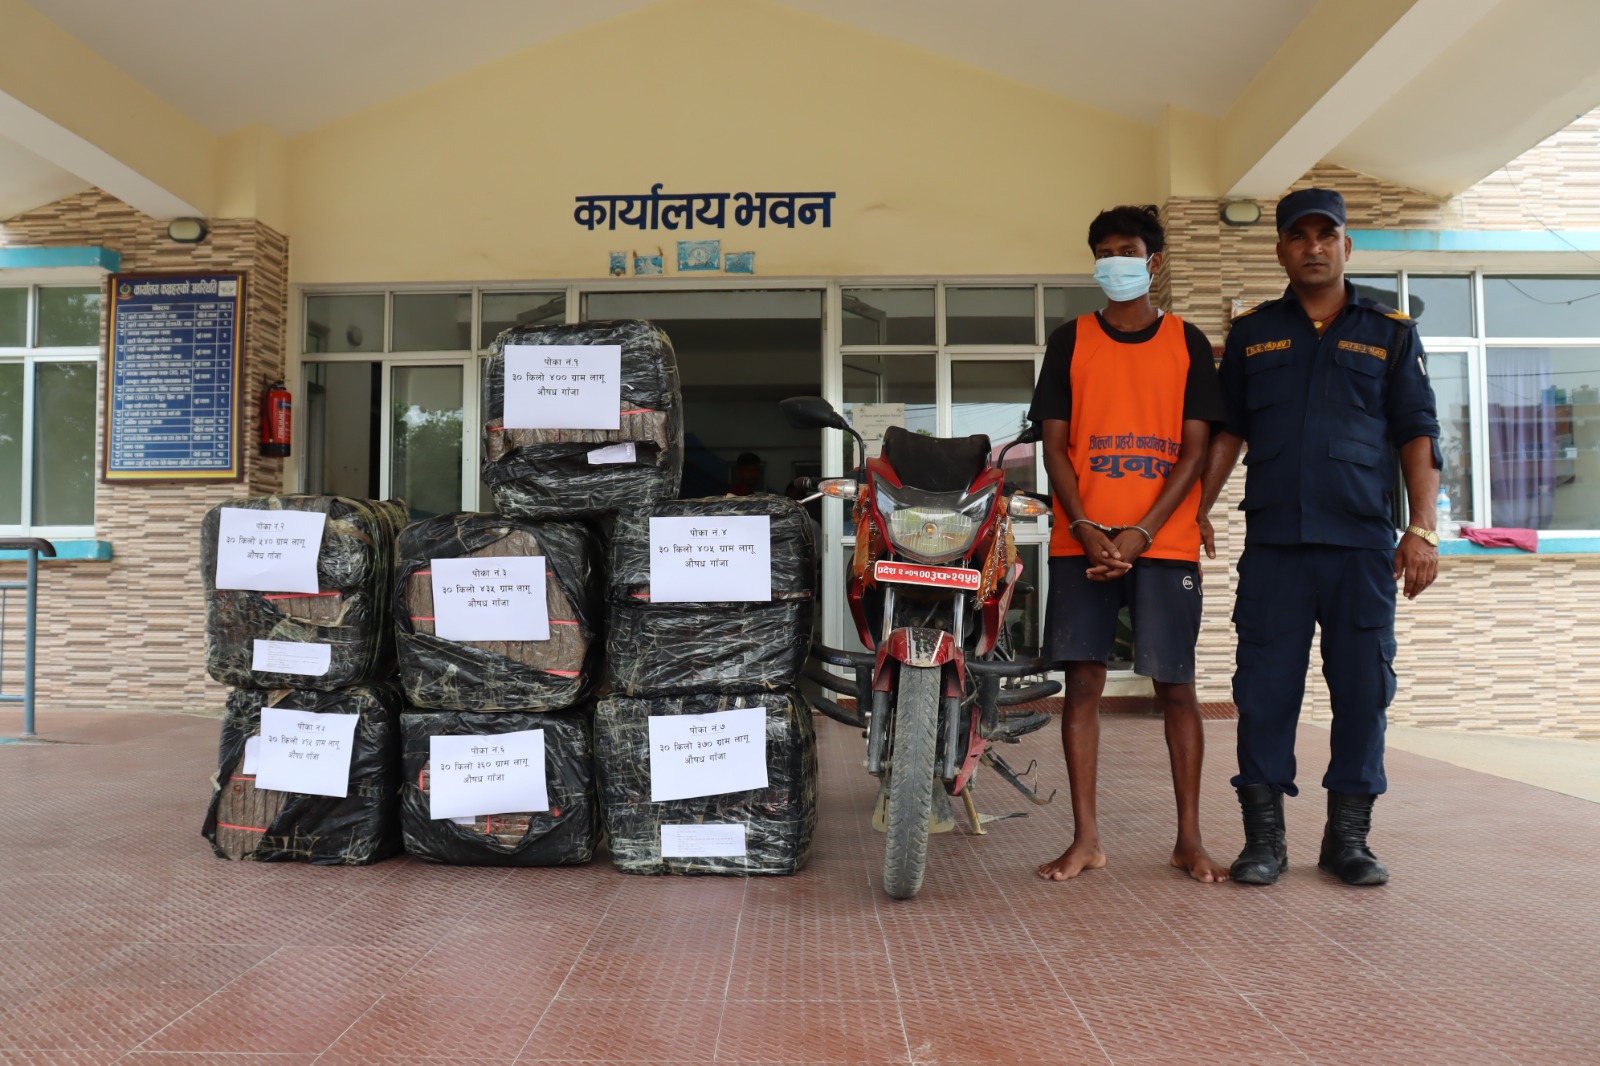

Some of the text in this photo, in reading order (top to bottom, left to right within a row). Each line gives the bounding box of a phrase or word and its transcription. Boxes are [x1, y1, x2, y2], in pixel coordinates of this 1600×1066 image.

[574, 183, 836, 230] कार्यालय भवन
[544, 357, 561, 366] पोका
[527, 372, 544, 381] किलो
[537, 386, 557, 396] औषध
[1089, 435, 1113, 450] जिल्ला
[1115, 432, 1134, 450] प्रहरी
[1136, 434, 1167, 453] कार्यालय
[690, 528, 708, 537] पोका
[659, 546, 669, 554] ३०
[673, 544, 692, 553] किलो
[697, 545, 714, 553] ४०५
[685, 558, 706, 567] औषध
[472, 569, 490, 577] पोका
[877, 566, 896, 575] प्रदेश
[456, 584, 475, 593] किलो
[480, 585, 495, 593] ४३५
[468, 598, 488, 607] औषध
[689, 725, 707, 734] पोका
[660, 744, 670, 752] ३०
[674, 742, 693, 751] किलो
[717, 738, 730, 746] ग्राम
[471, 746, 488, 755] पोका
[685, 754, 705, 764] औषध
[440, 763, 450, 771] ३०
[455, 761, 473, 771] किलो
[496, 760, 510, 768] ग्राम
[464, 774, 483, 783] औषध
